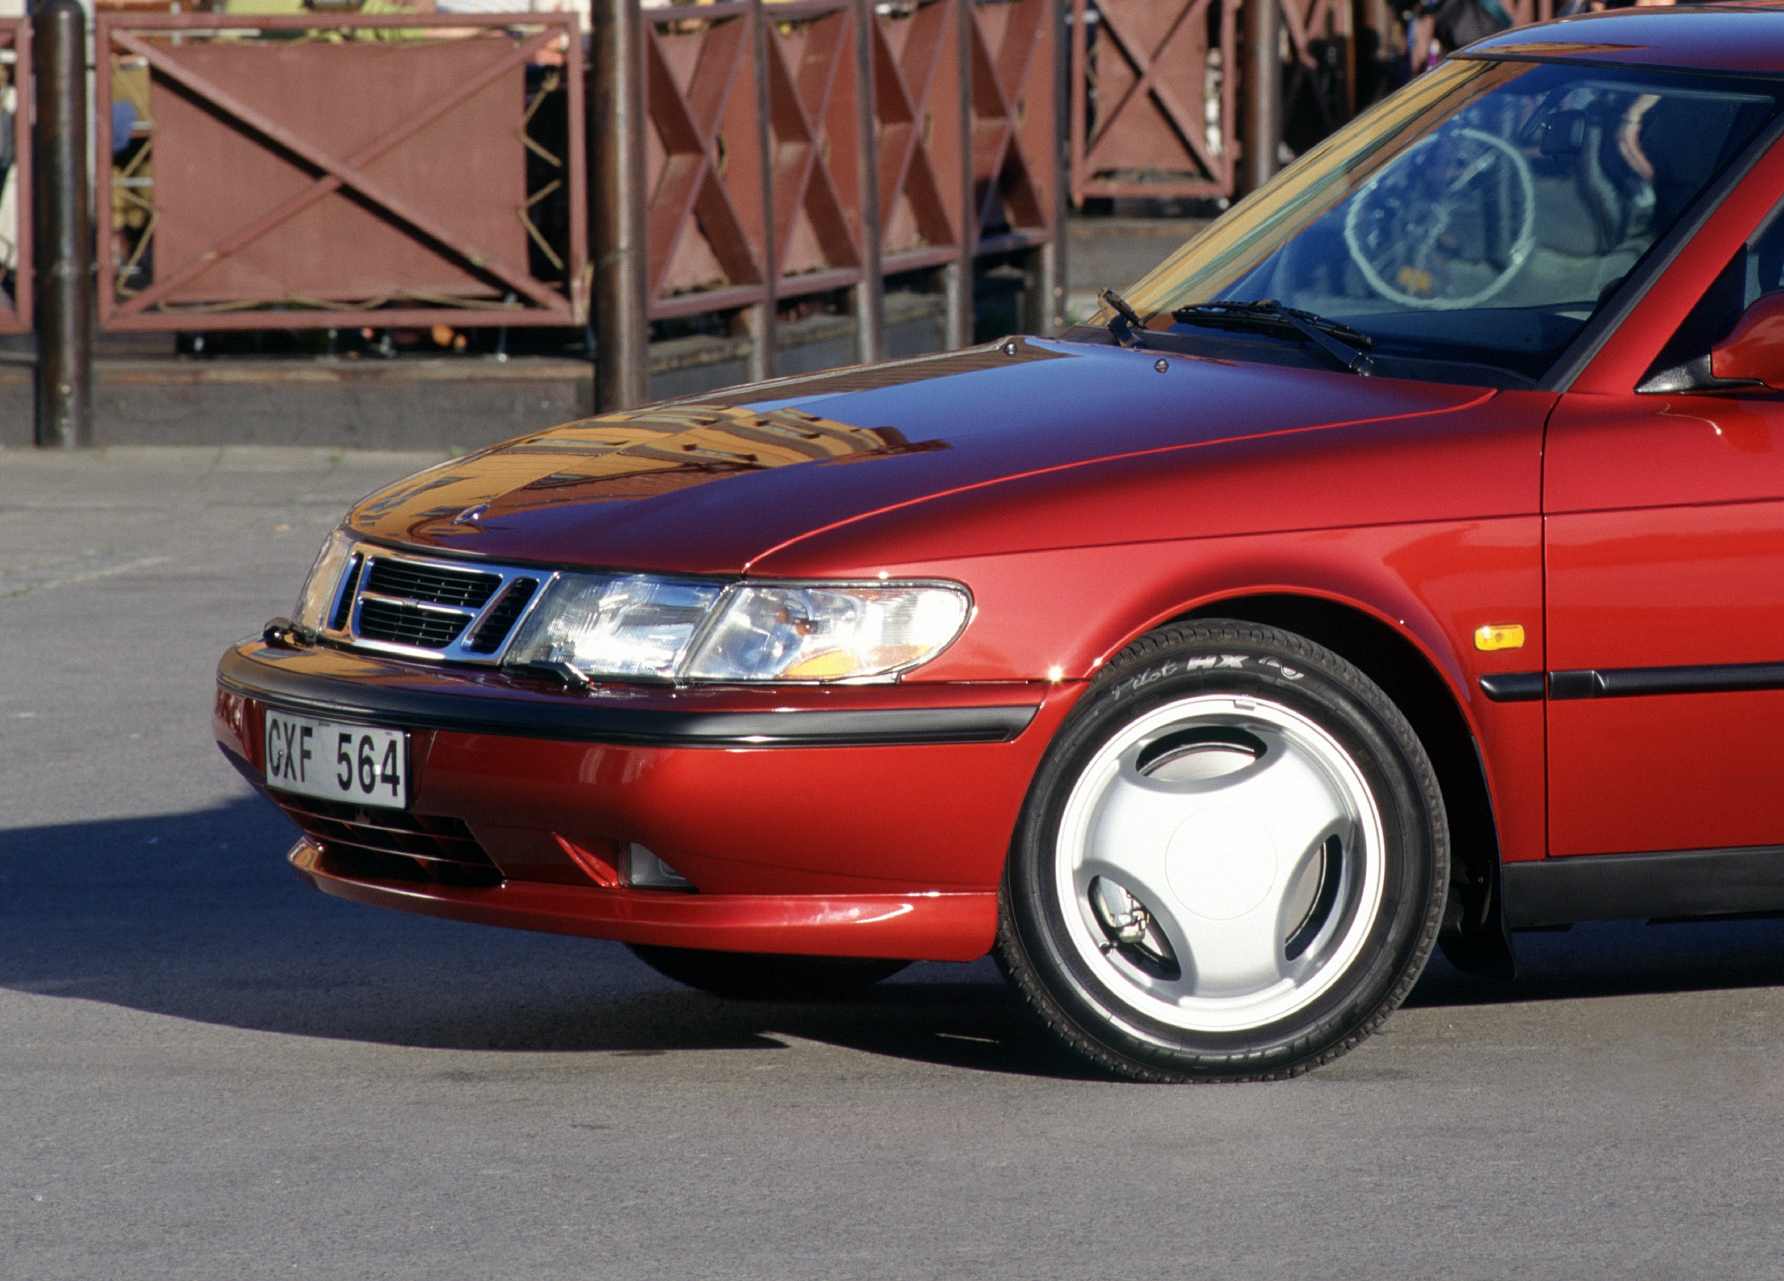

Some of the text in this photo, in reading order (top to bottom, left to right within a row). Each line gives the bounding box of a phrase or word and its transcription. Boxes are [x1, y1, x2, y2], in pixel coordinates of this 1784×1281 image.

[1186, 654, 1250, 672] HX
[268, 717, 401, 798] CXF 564
